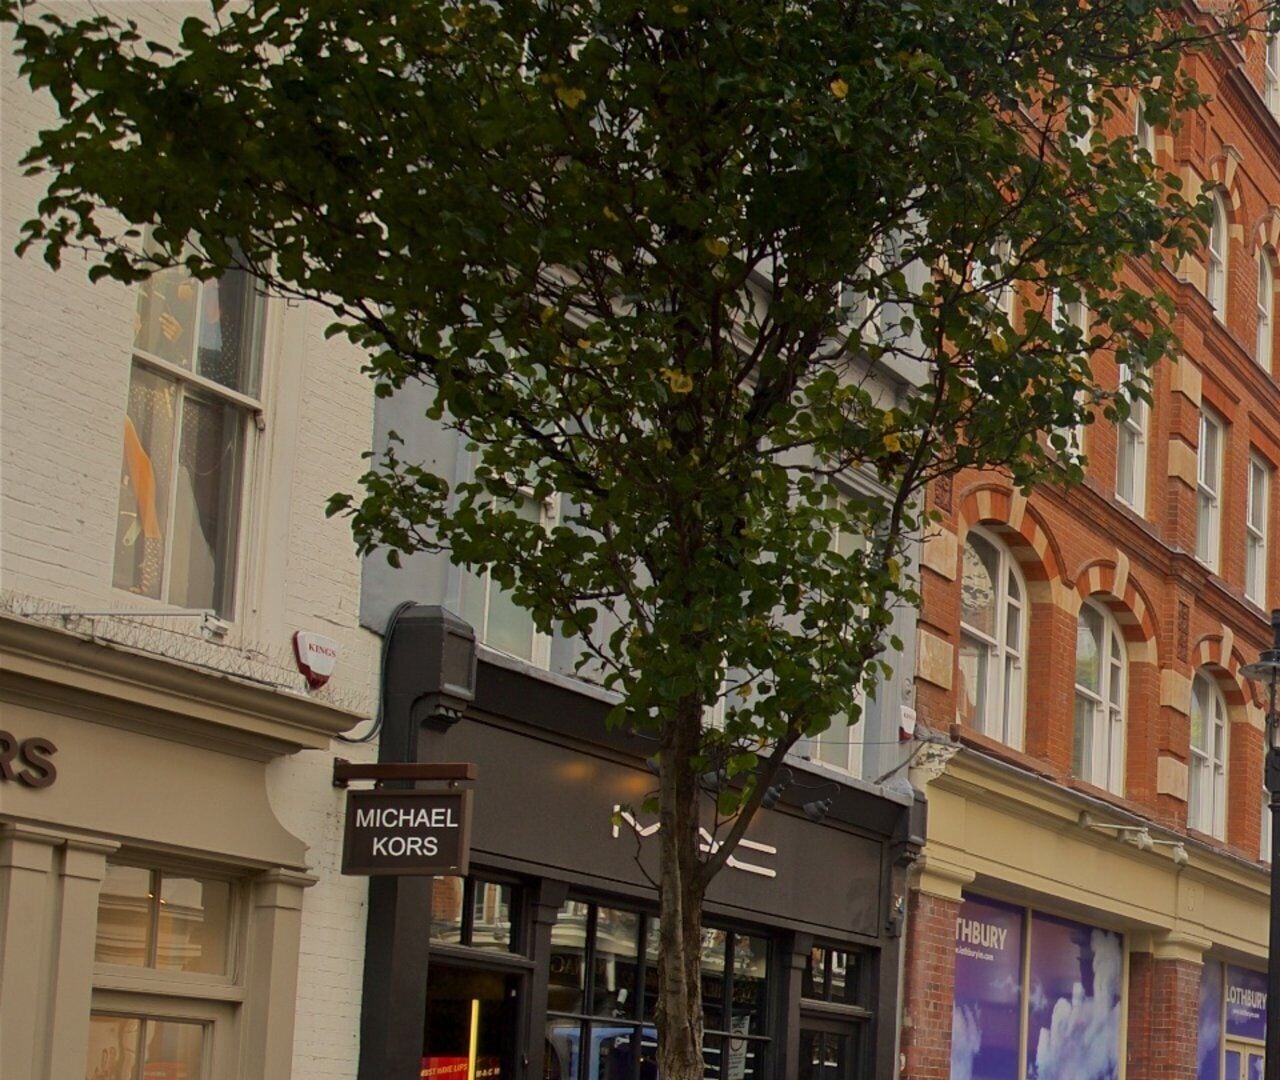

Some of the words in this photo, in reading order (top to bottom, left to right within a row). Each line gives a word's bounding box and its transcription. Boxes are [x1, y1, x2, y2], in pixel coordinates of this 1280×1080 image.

[308, 642, 337, 659] KINGS
[356, 808, 458, 829] MICHAEL
[372, 837, 438, 858] KORS
[1226, 985, 1268, 1010] LOTHBURY
